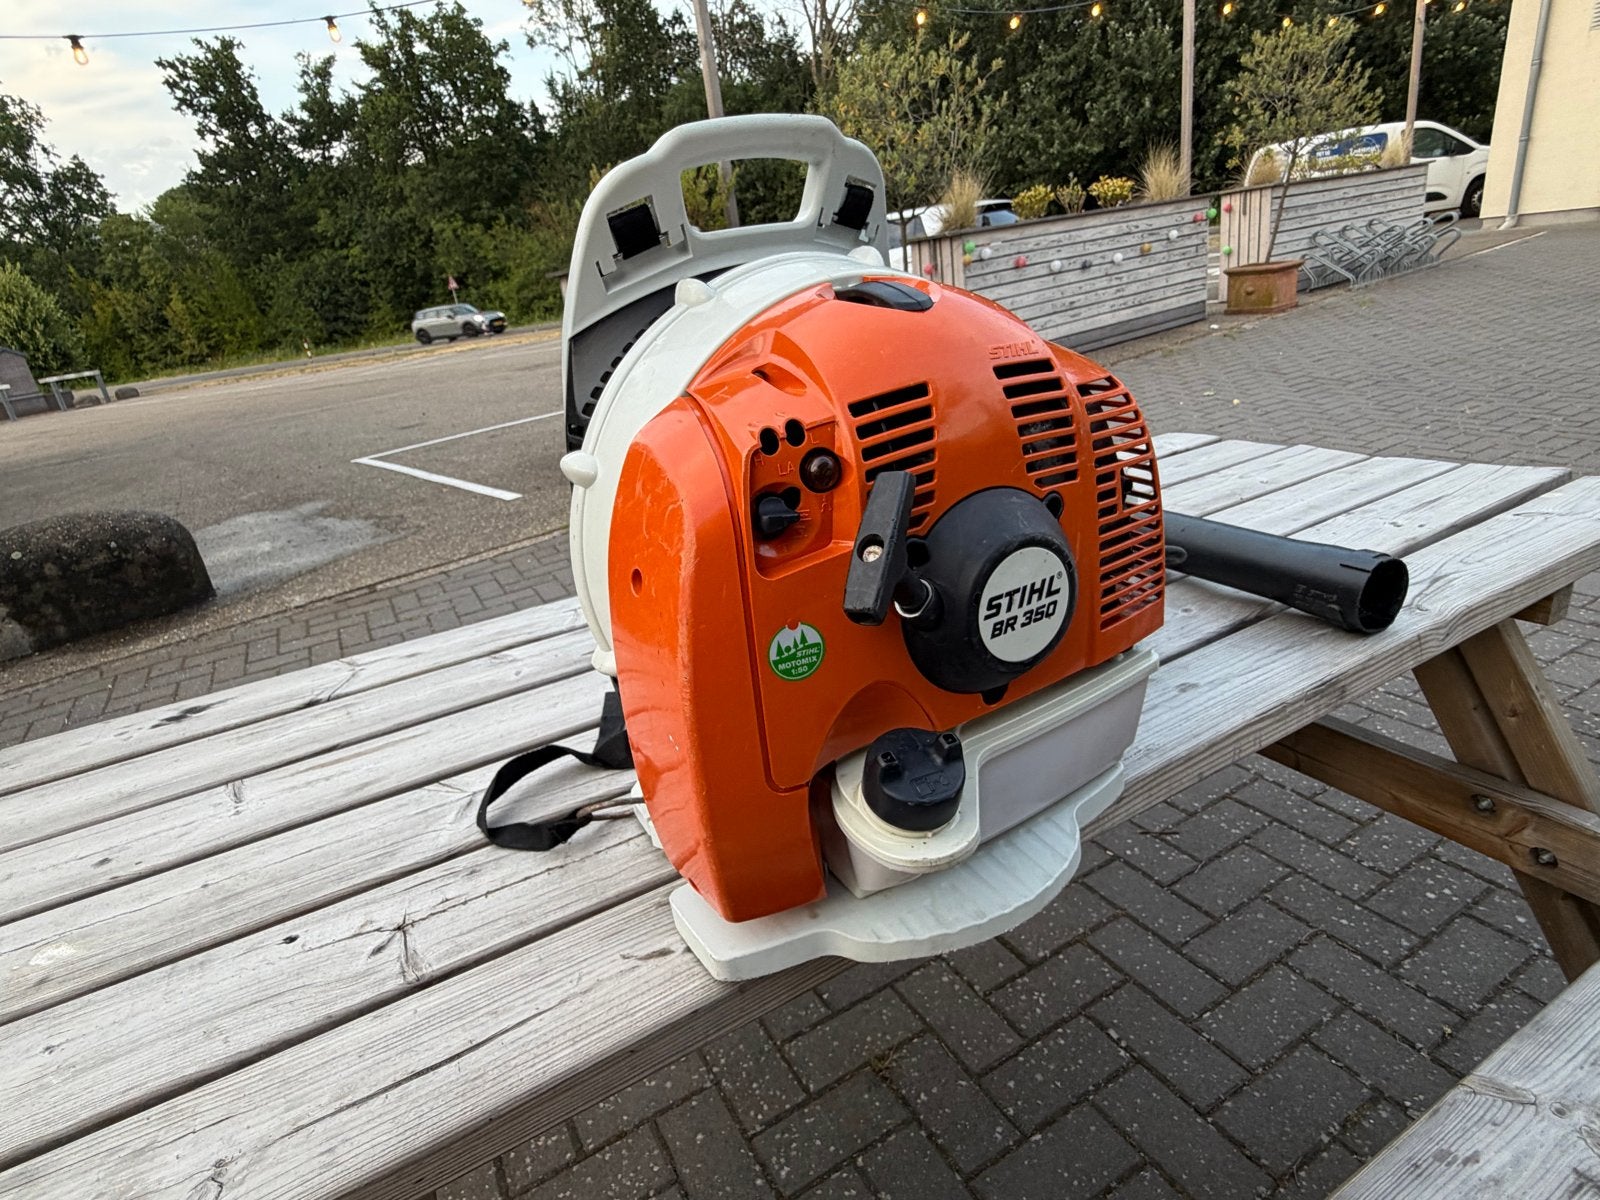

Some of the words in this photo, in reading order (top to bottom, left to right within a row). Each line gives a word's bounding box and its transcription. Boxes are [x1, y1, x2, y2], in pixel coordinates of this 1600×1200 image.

[988, 341, 1039, 360] STIHL
[990, 615, 1018, 640] BR
[1020, 599, 1058, 629] 350
[796, 646, 820, 658] STIHL
[778, 655, 817, 671] MOTOMIX
[791, 665, 808, 675] 1:50
